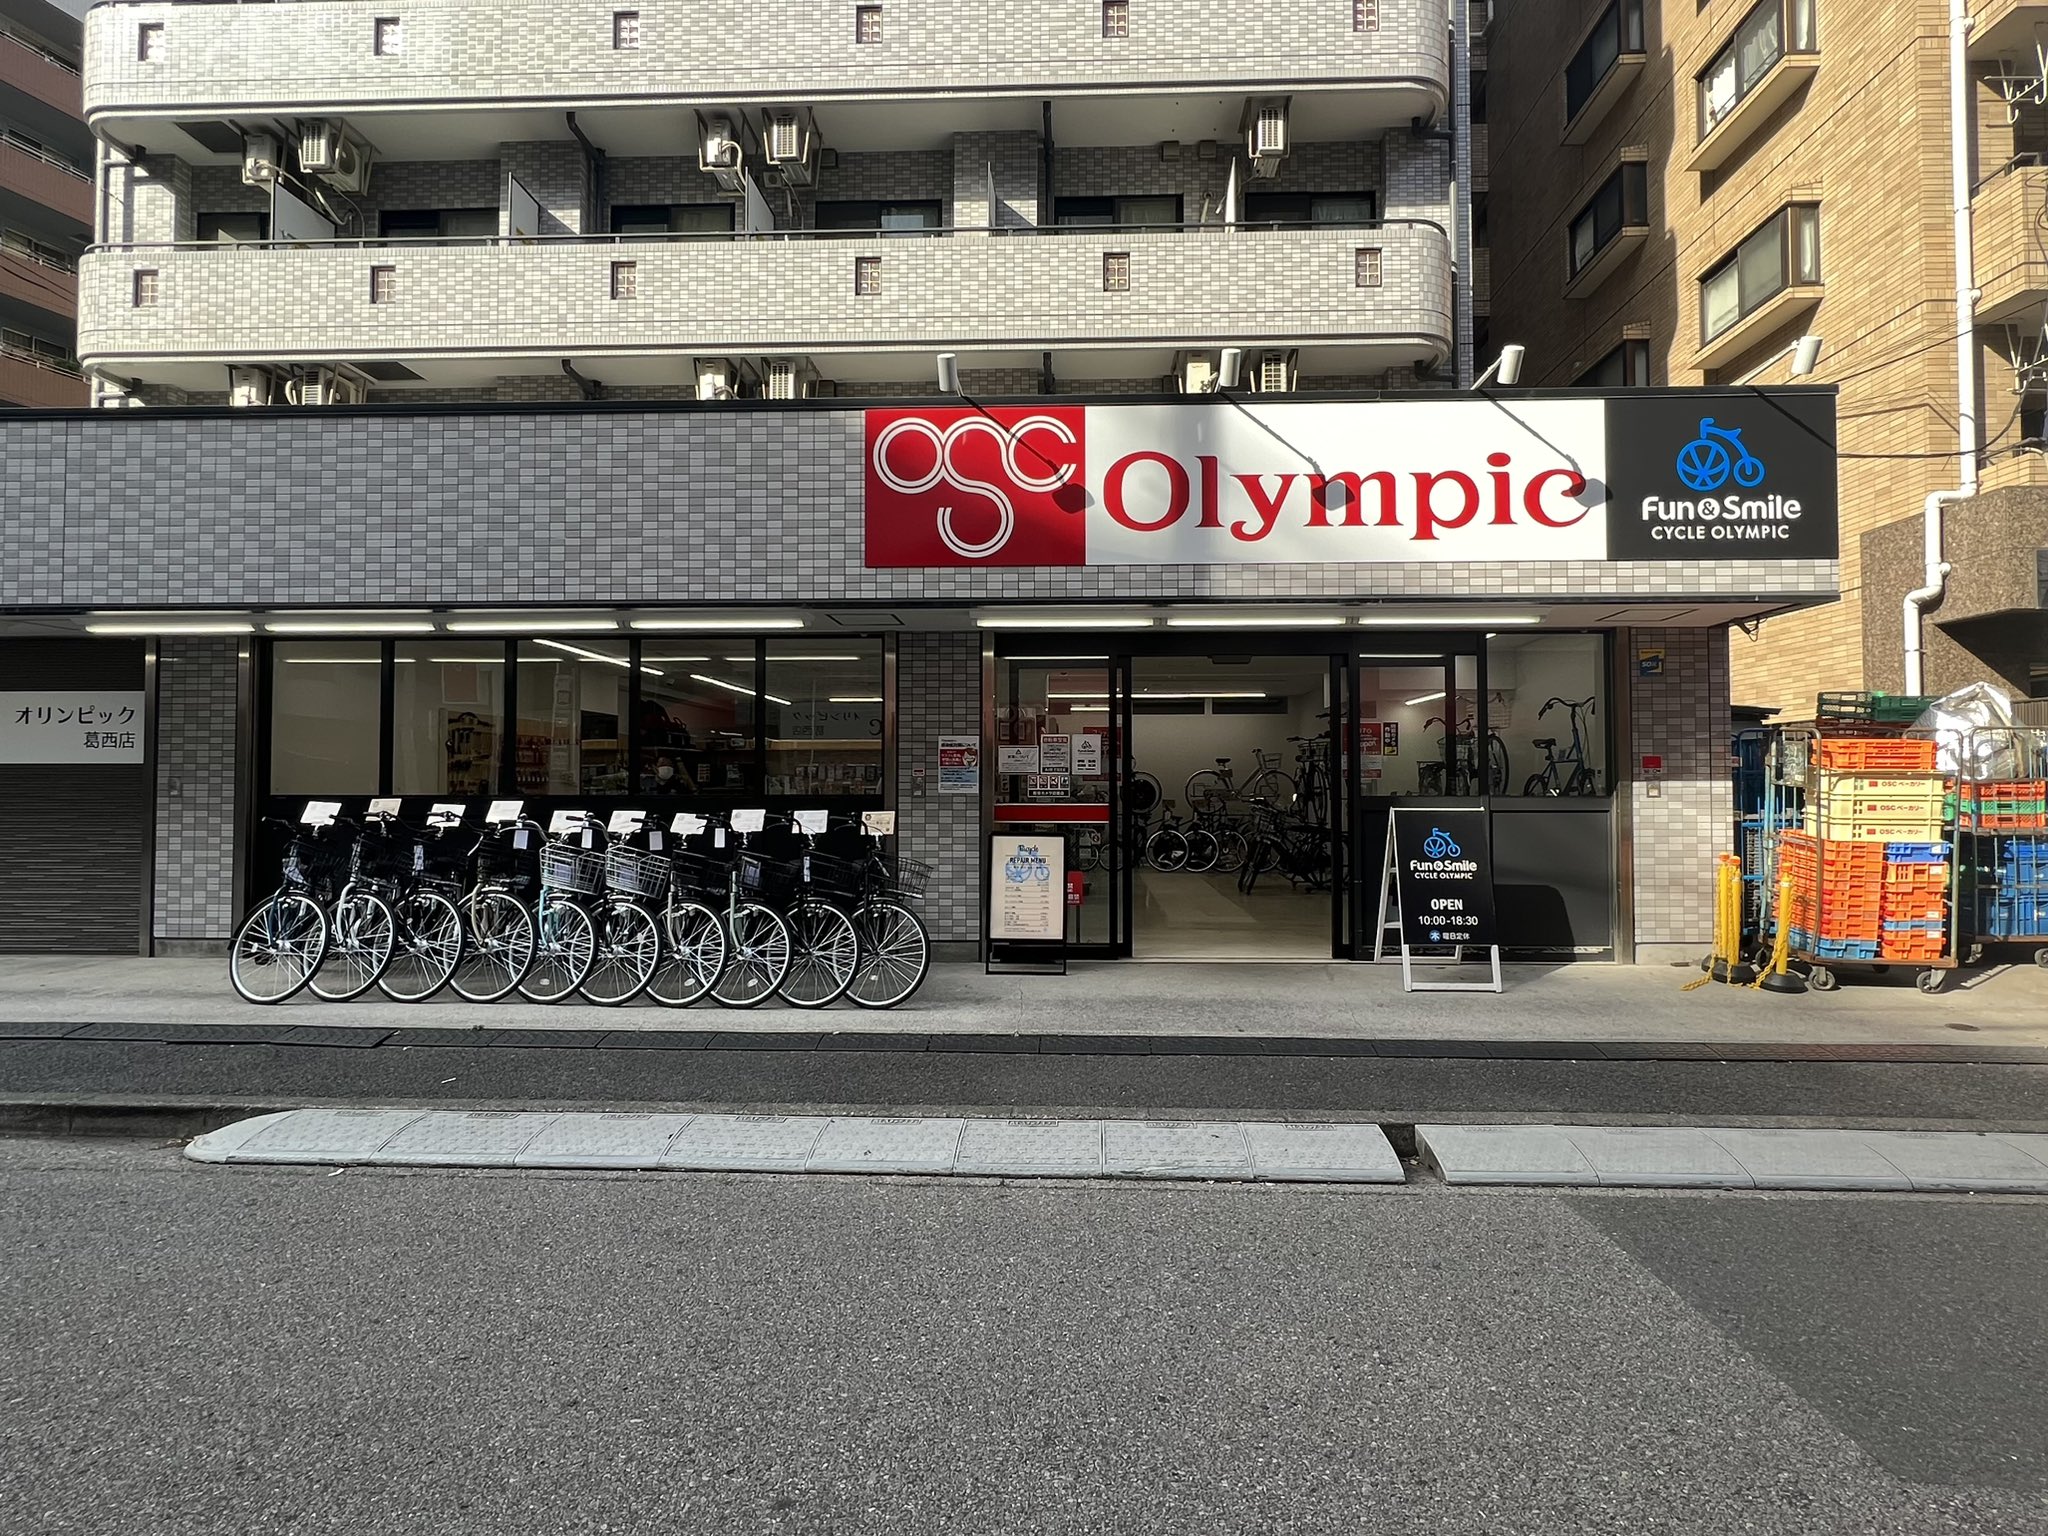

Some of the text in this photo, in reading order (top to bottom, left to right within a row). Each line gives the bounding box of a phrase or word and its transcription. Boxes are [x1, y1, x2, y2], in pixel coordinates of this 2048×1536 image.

[1102, 451, 1592, 543] Olympic
[1651, 525, 1790, 541] CYCLE OLYMPIC
[14, 705, 137, 726] オリンピック
[83, 730, 137, 750] 葛西店
[1439, 872, 1474, 880] OLYMPIC
[1430, 898, 1464, 911] OPEN
[1418, 915, 1479, 926] 10:00-18:30
